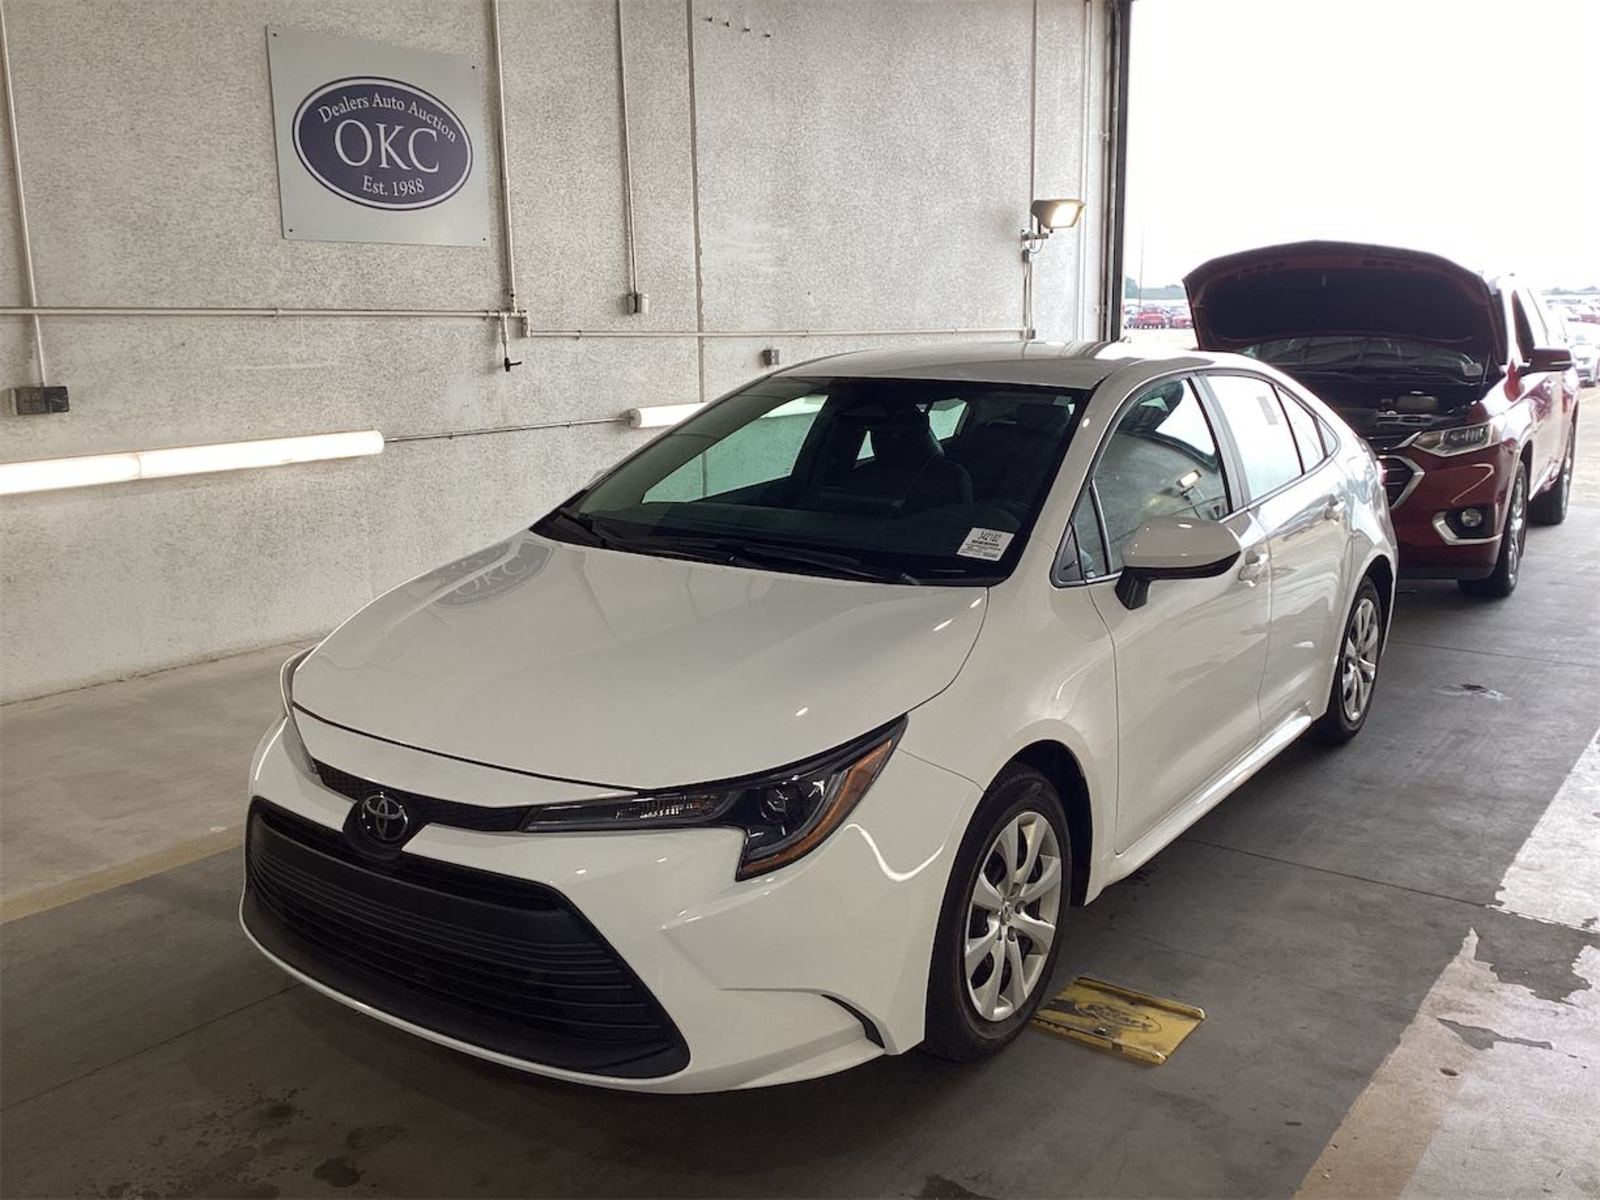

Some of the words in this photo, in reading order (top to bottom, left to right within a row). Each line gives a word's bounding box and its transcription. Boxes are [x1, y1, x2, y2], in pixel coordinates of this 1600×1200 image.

[318, 95, 369, 124] Dealers
[372, 92, 405, 111] Auto
[407, 101, 456, 143] Auction
[334, 119, 440, 173] OKC
[362, 175, 388, 196] Est.
[392, 177, 425, 196] 1988
